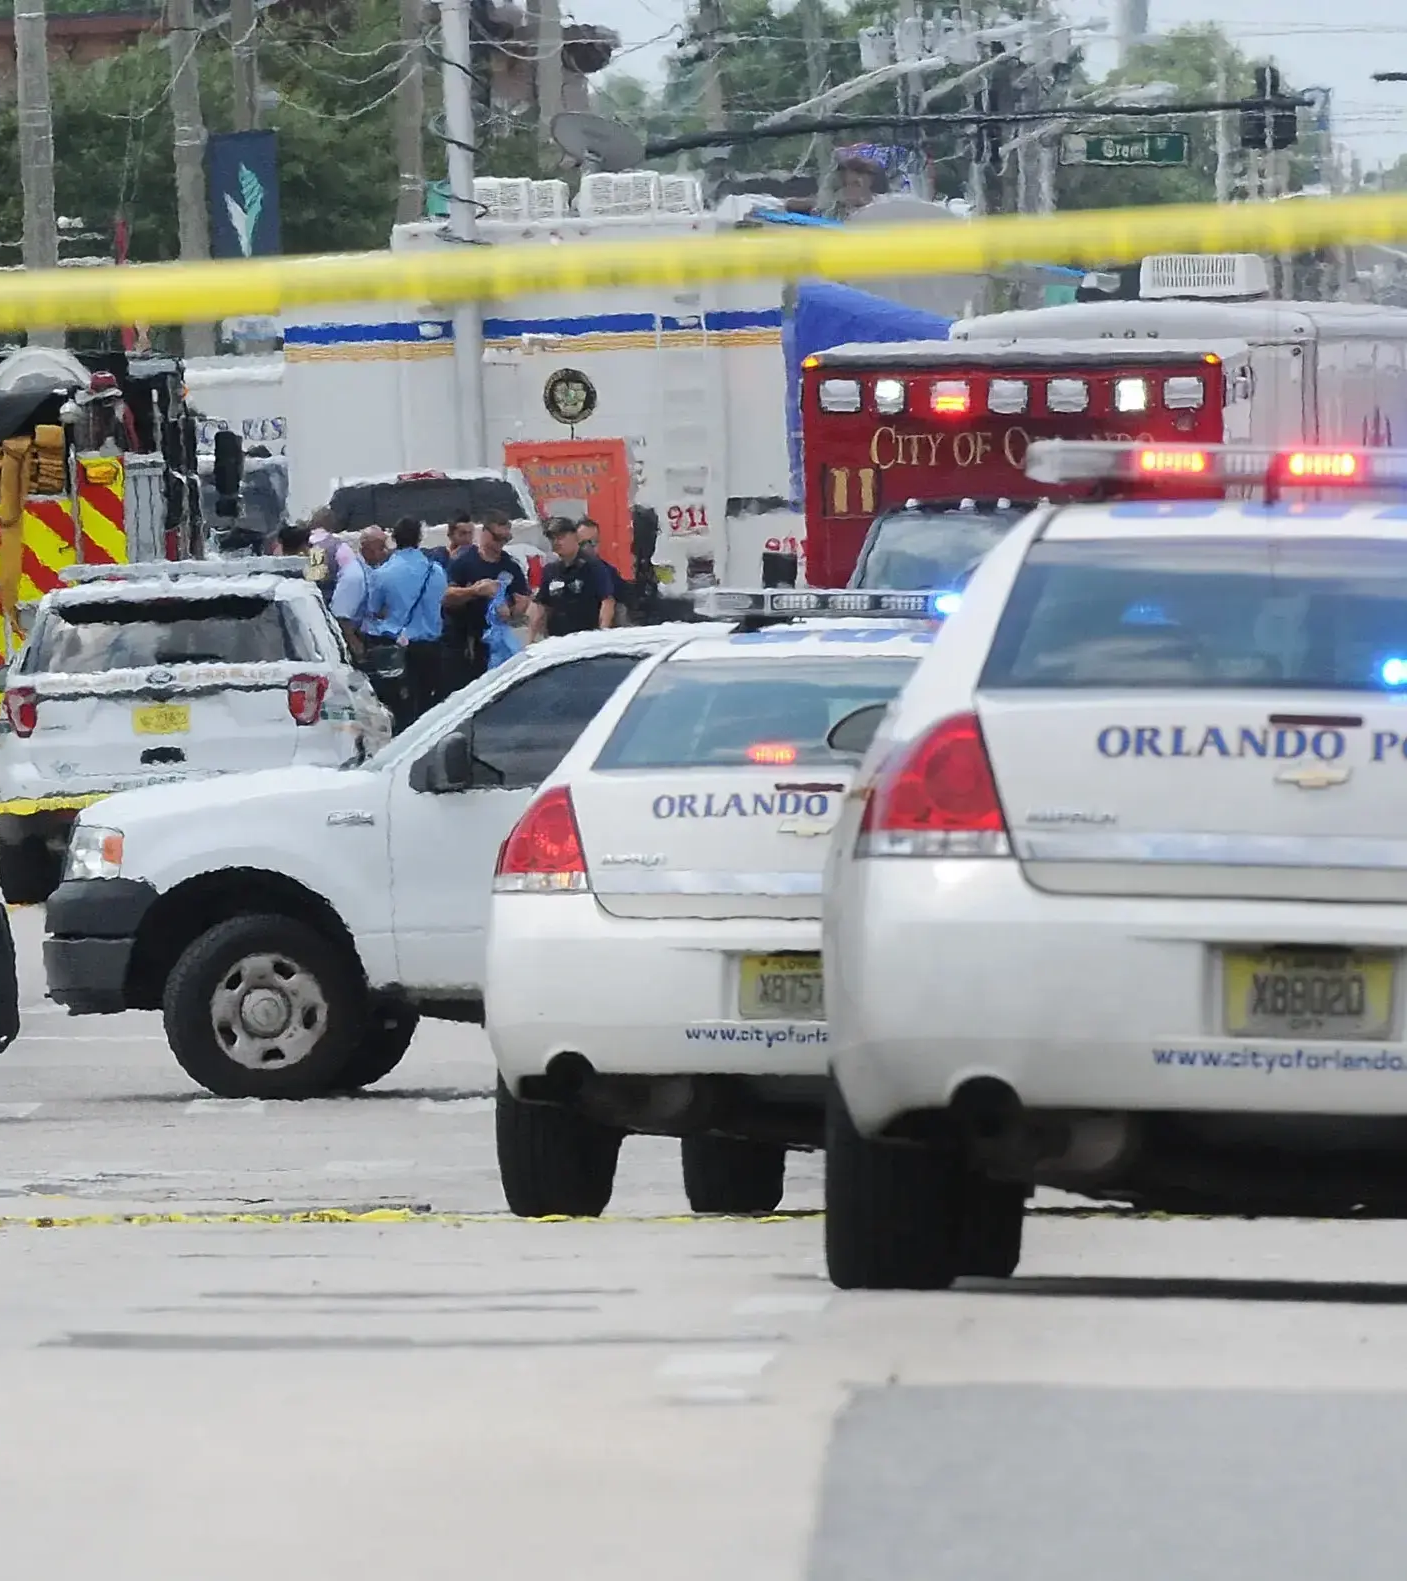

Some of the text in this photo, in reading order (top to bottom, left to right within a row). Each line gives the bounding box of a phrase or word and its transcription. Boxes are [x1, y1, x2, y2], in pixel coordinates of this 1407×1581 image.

[667, 505, 709, 530] 911
[1096, 724, 1347, 761] ORLANDO
[652, 793, 830, 820] ORLANDO
